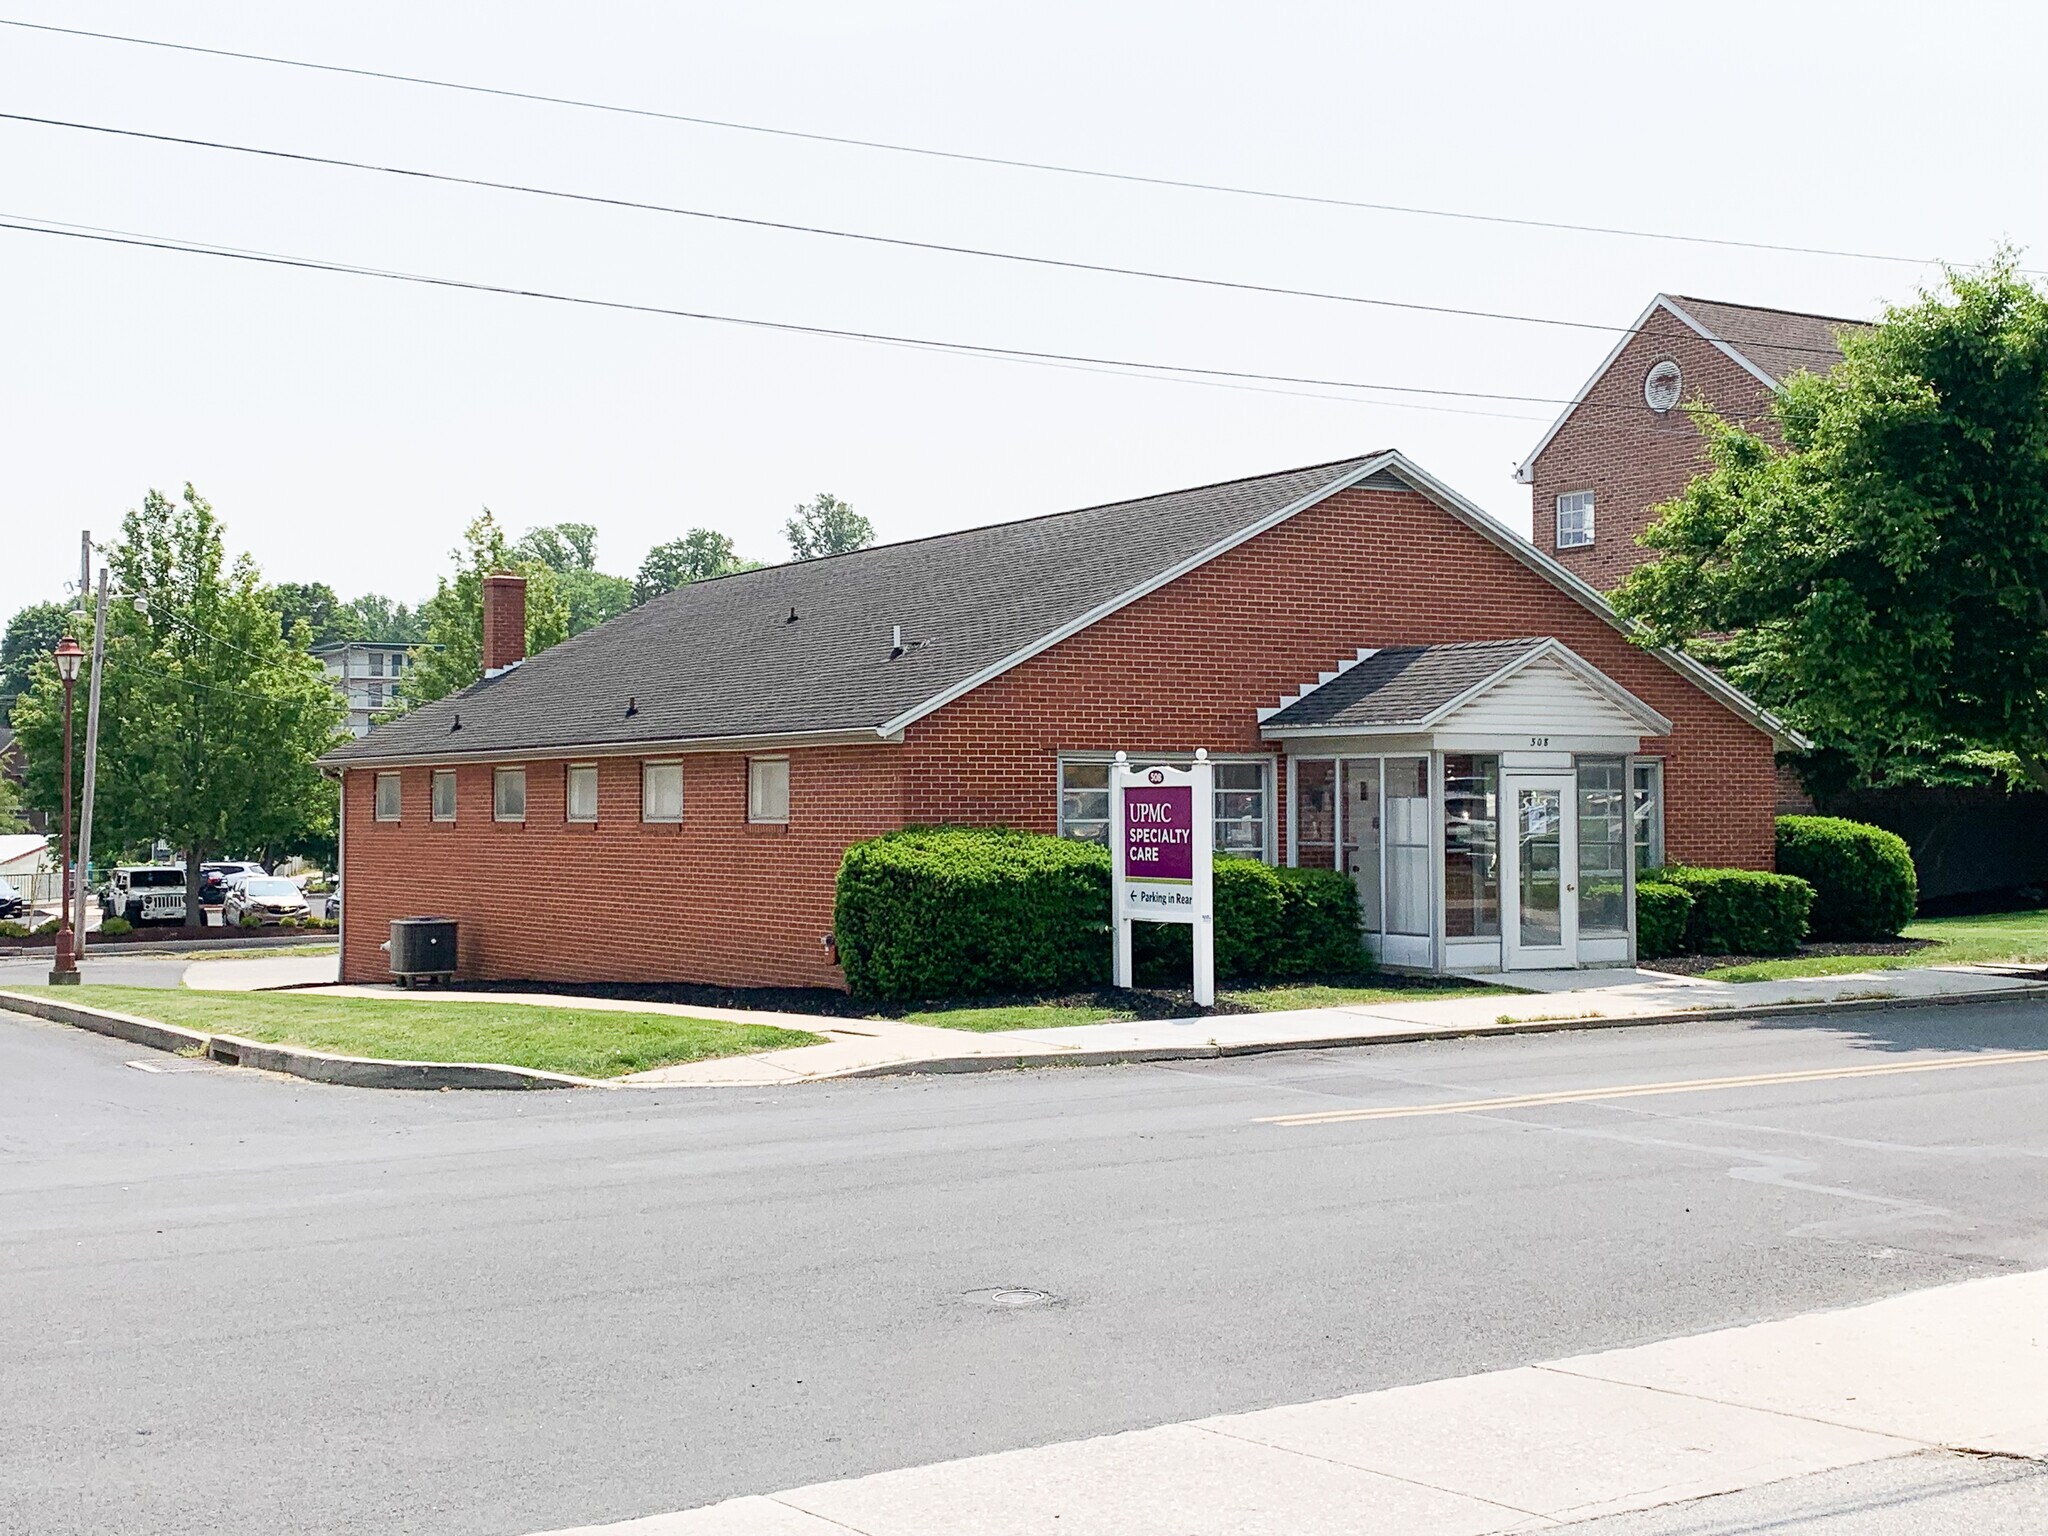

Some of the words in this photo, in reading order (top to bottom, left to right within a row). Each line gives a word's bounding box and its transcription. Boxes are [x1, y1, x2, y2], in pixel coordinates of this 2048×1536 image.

[1530, 737, 1549, 747] 508
[1129, 803, 1172, 823] UPMC
[1129, 828, 1190, 844] SPECIALTY
[1129, 846, 1159, 862] CARE
[1140, 890, 1167, 906] Parking
[1168, 892, 1175, 904] in
[1176, 892, 1193, 905] Rear
